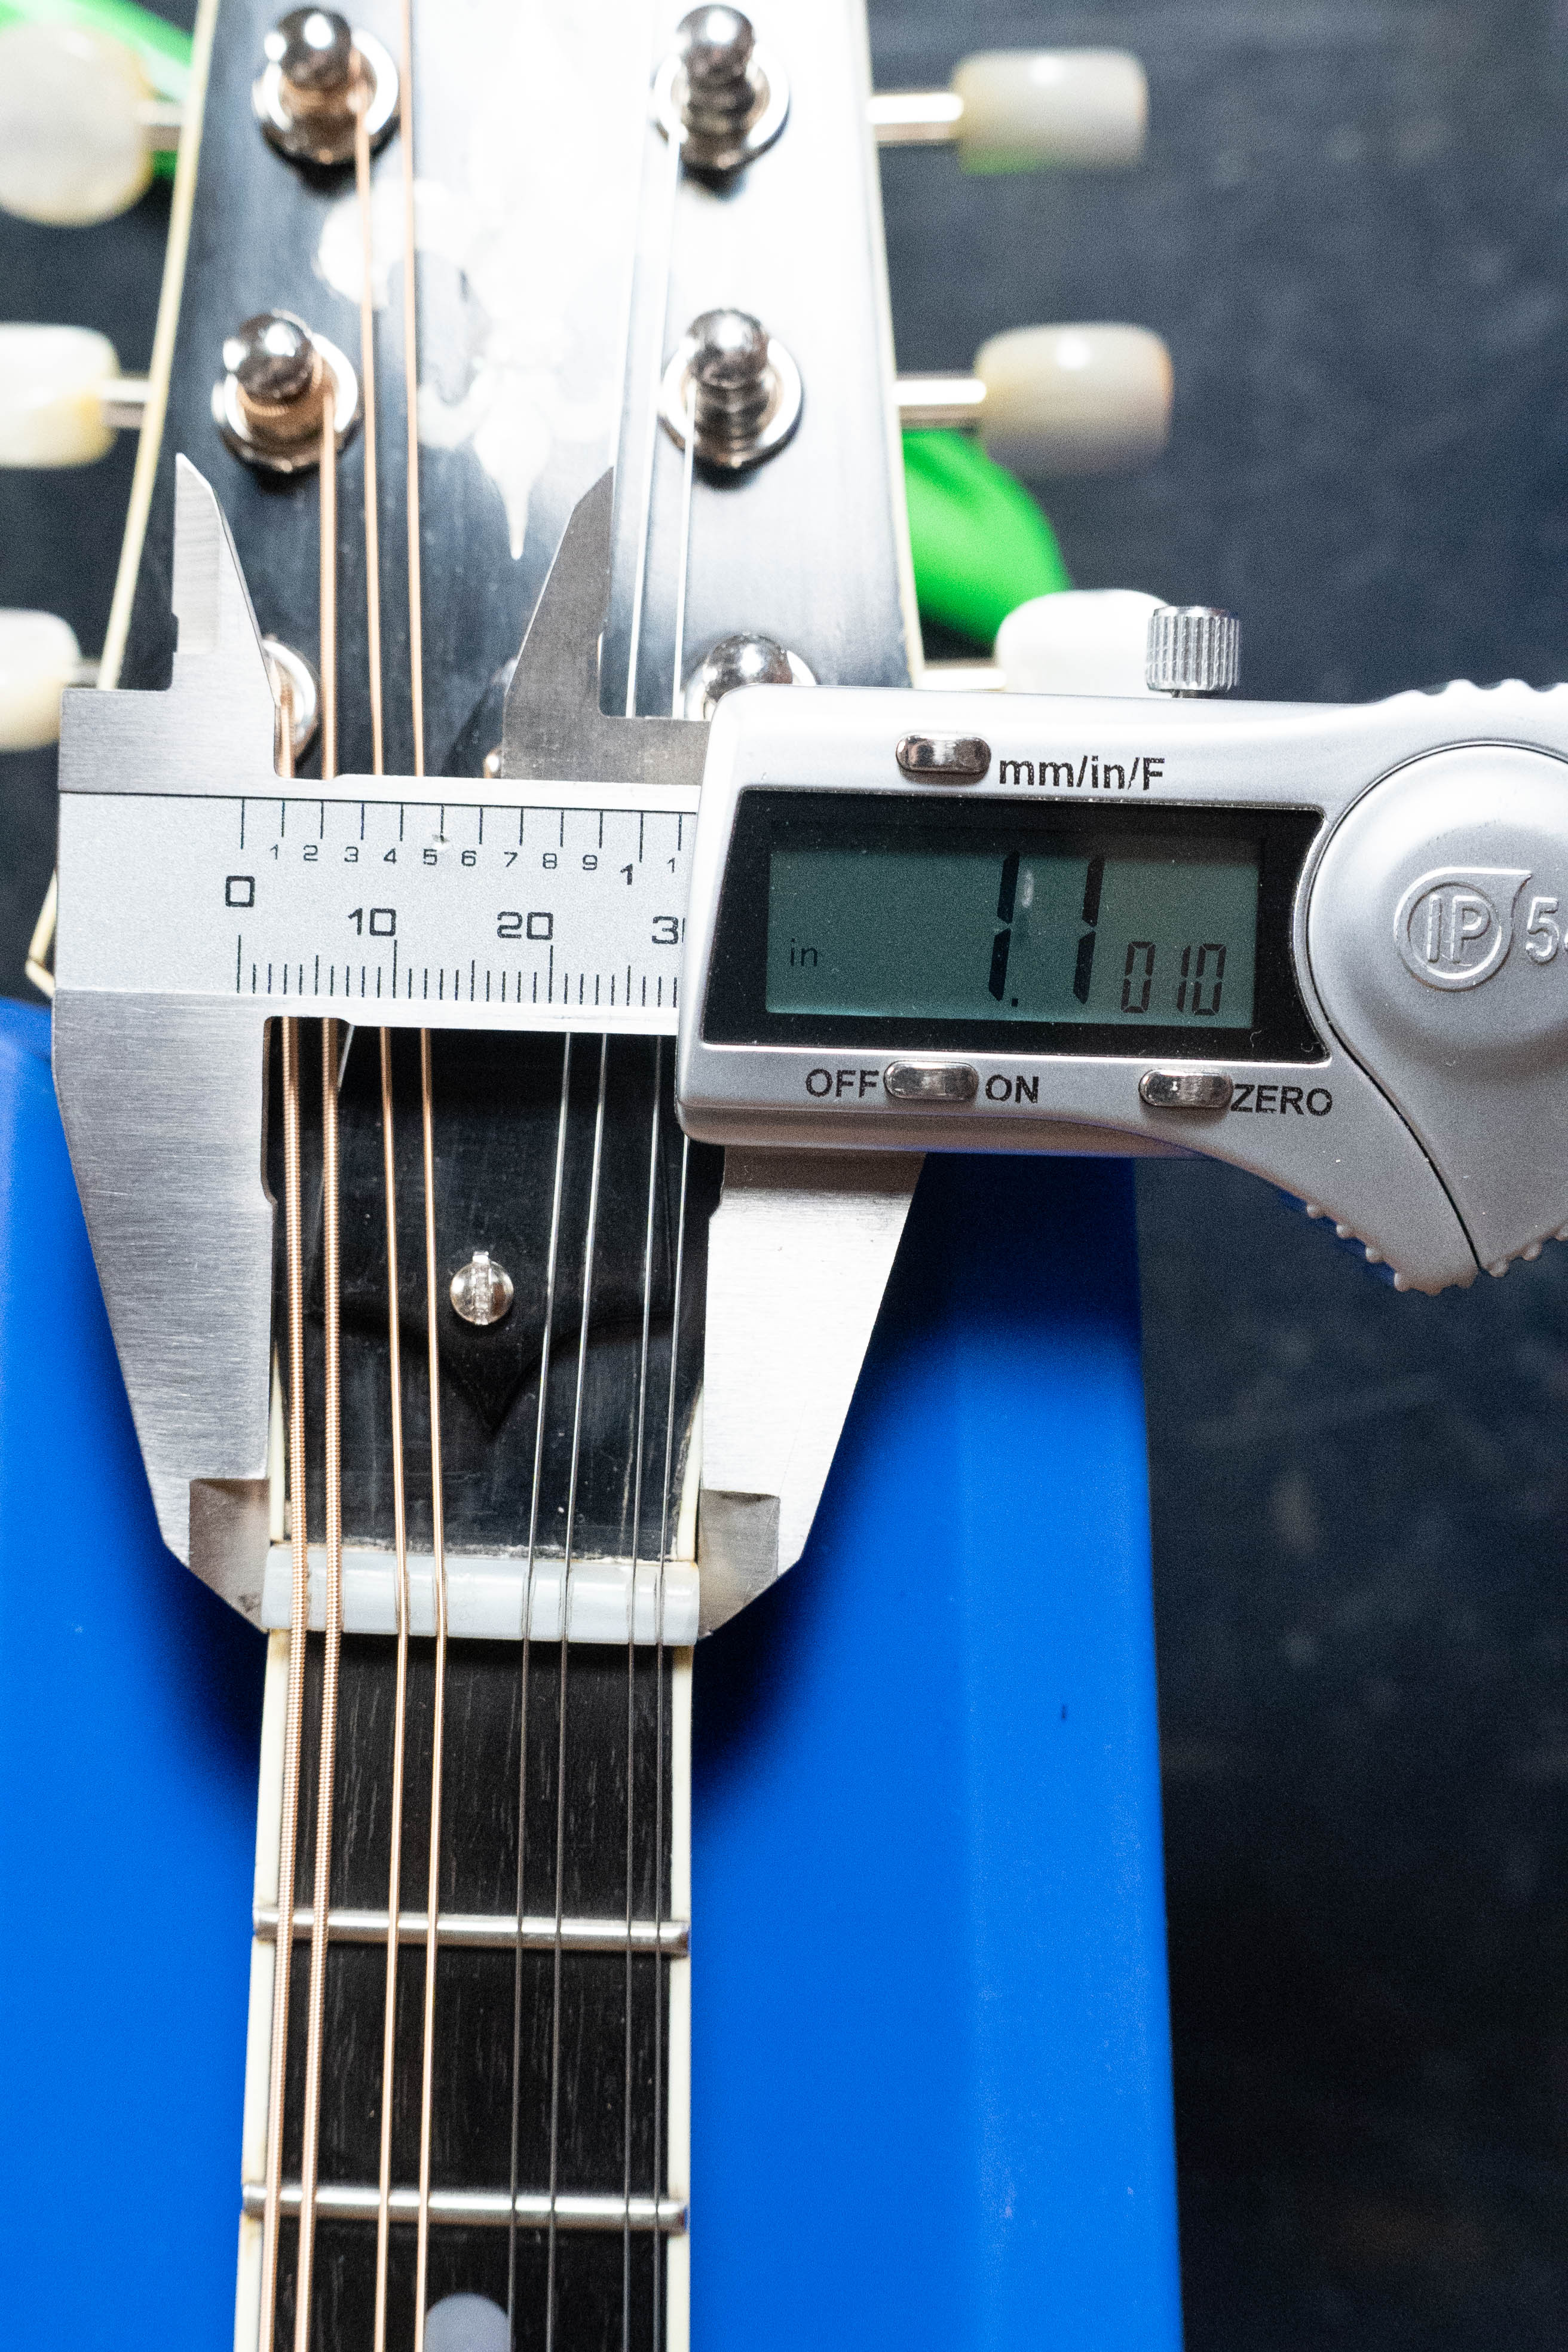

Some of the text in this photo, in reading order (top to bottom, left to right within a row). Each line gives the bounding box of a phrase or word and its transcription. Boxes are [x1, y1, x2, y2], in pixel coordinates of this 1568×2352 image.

[999, 754, 1165, 791] mm/in/F
[270, 844, 676, 886] 1 2 3 4 5 6 7 8 9 1 1
[225, 875, 685, 945] 0 10 20 3
[1525, 896, 1568, 966] 5
[789, 938, 819, 967] in
[805, 1068, 877, 1098] OFF
[985, 1075, 1039, 1104] ON
[1230, 1083, 1333, 1116] ZERO
